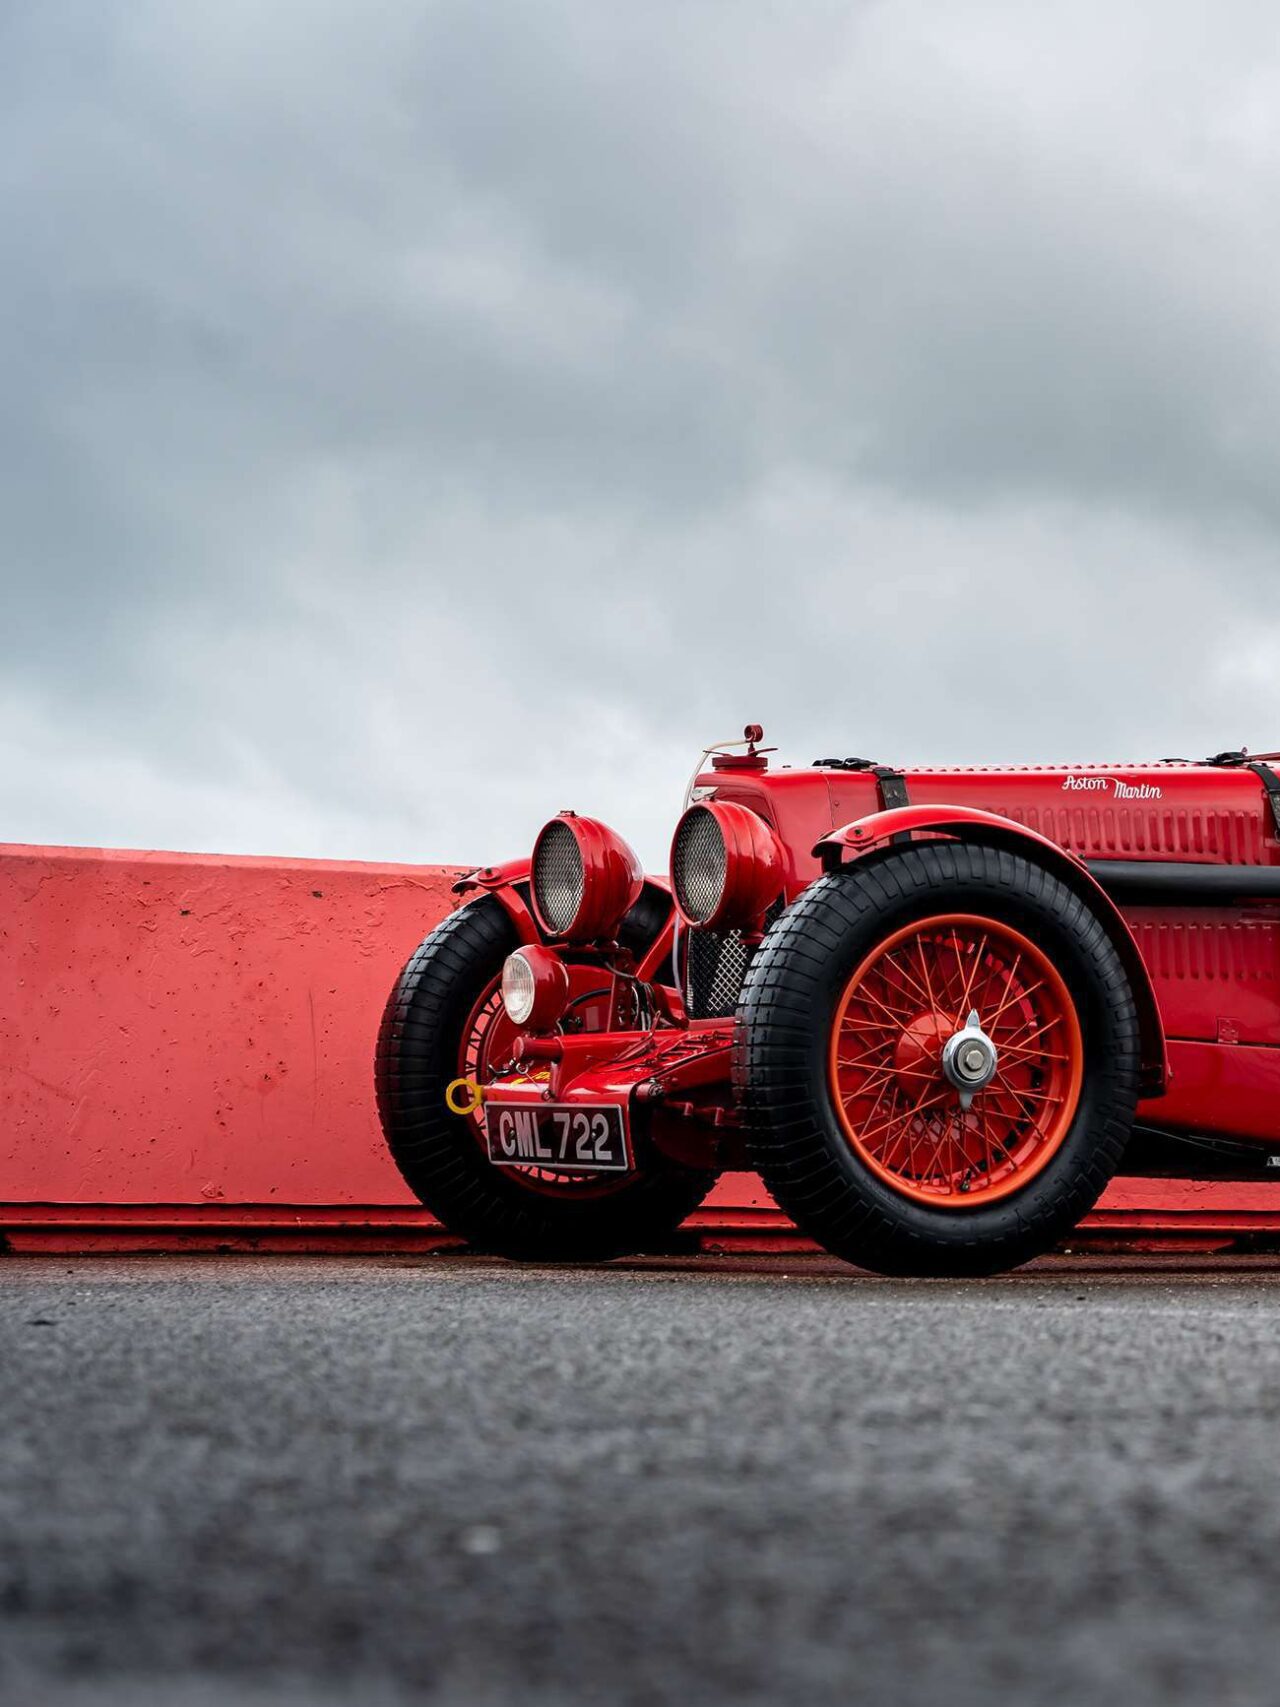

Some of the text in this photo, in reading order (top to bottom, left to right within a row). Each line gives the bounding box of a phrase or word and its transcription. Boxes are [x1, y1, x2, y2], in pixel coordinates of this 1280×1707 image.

[1061, 775, 1163, 799] Aston Martin
[499, 1110, 613, 1161] CML 722
